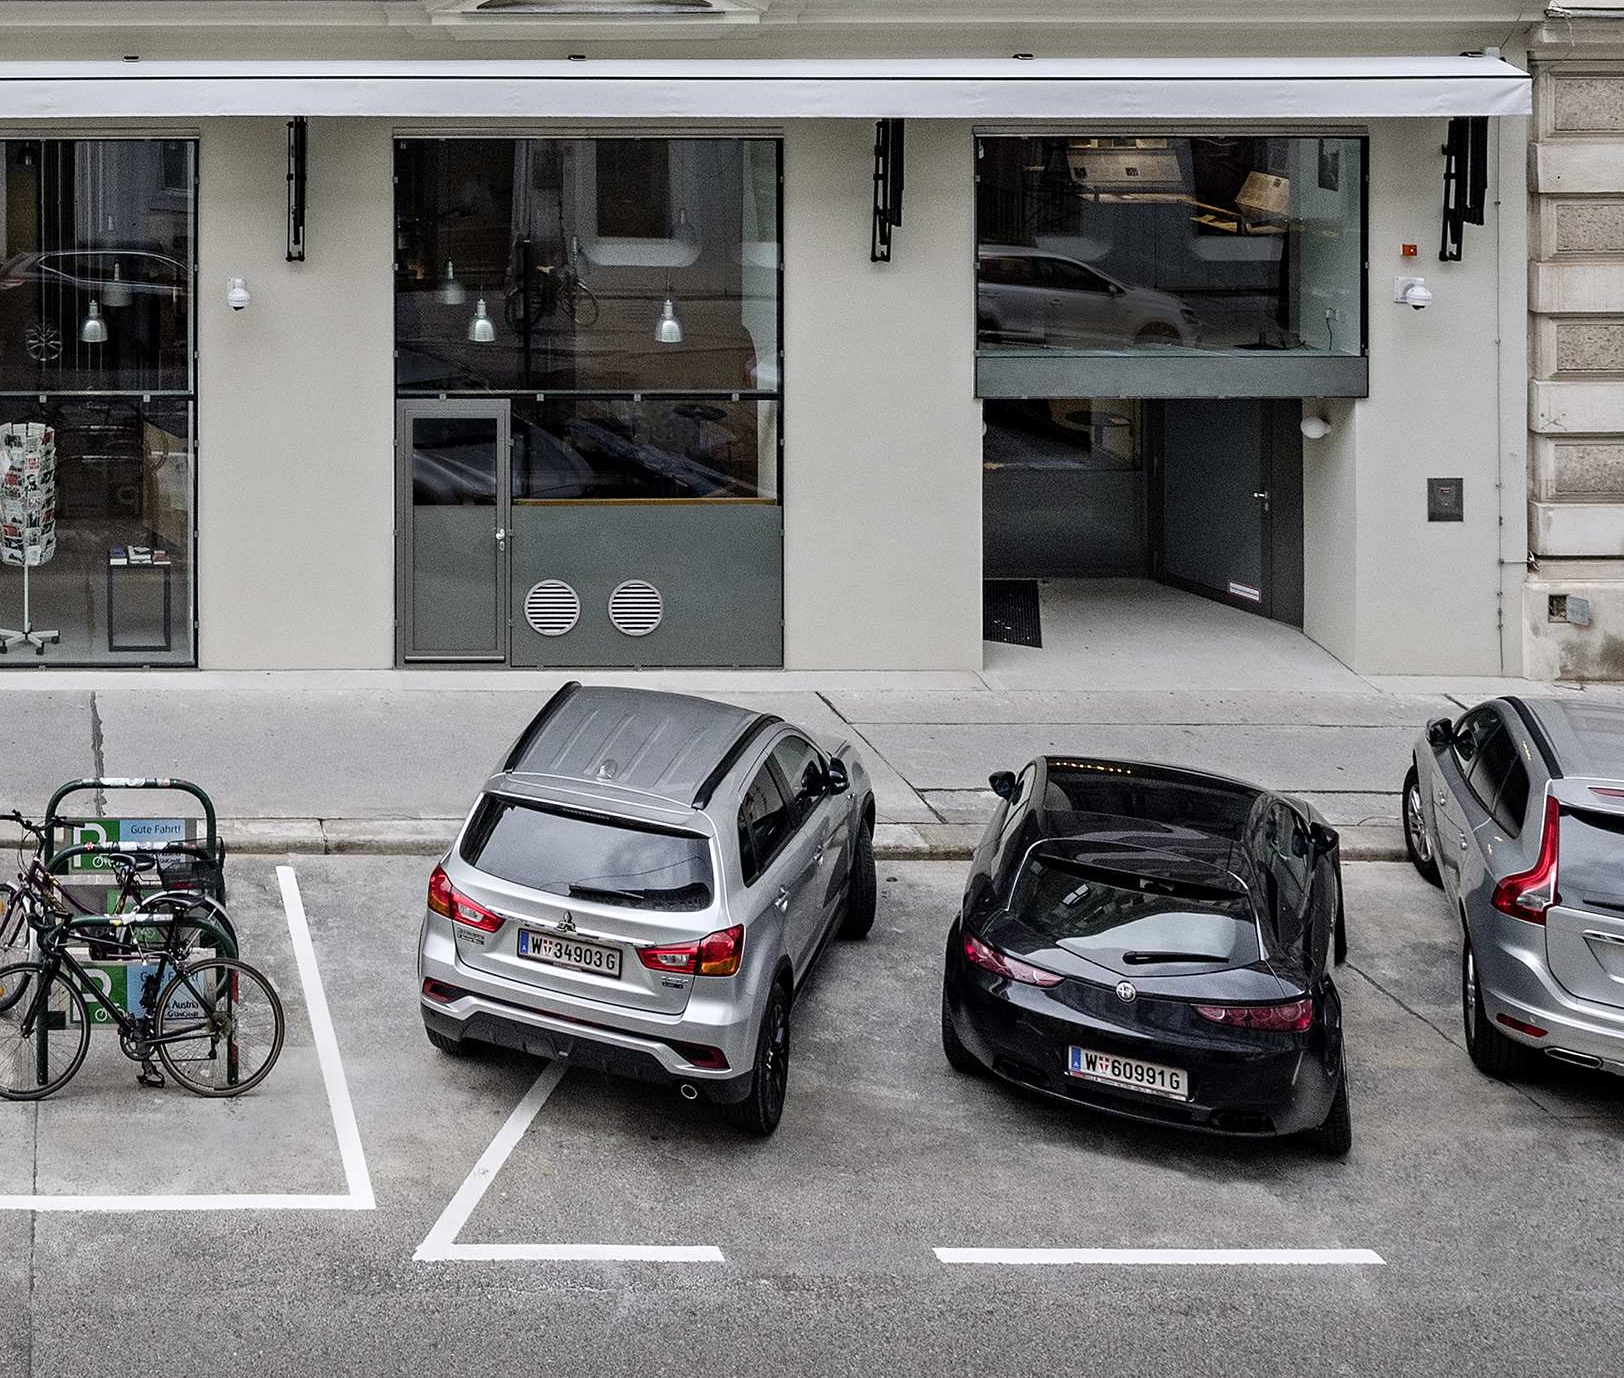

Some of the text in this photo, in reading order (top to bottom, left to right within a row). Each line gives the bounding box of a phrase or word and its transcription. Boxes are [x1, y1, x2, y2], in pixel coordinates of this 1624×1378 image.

[130, 824, 181, 835] Gute Fahrt!
[531, 936, 543, 955] W
[172, 1000, 199, 1009] Austria
[1085, 1052, 1097, 1072] W
